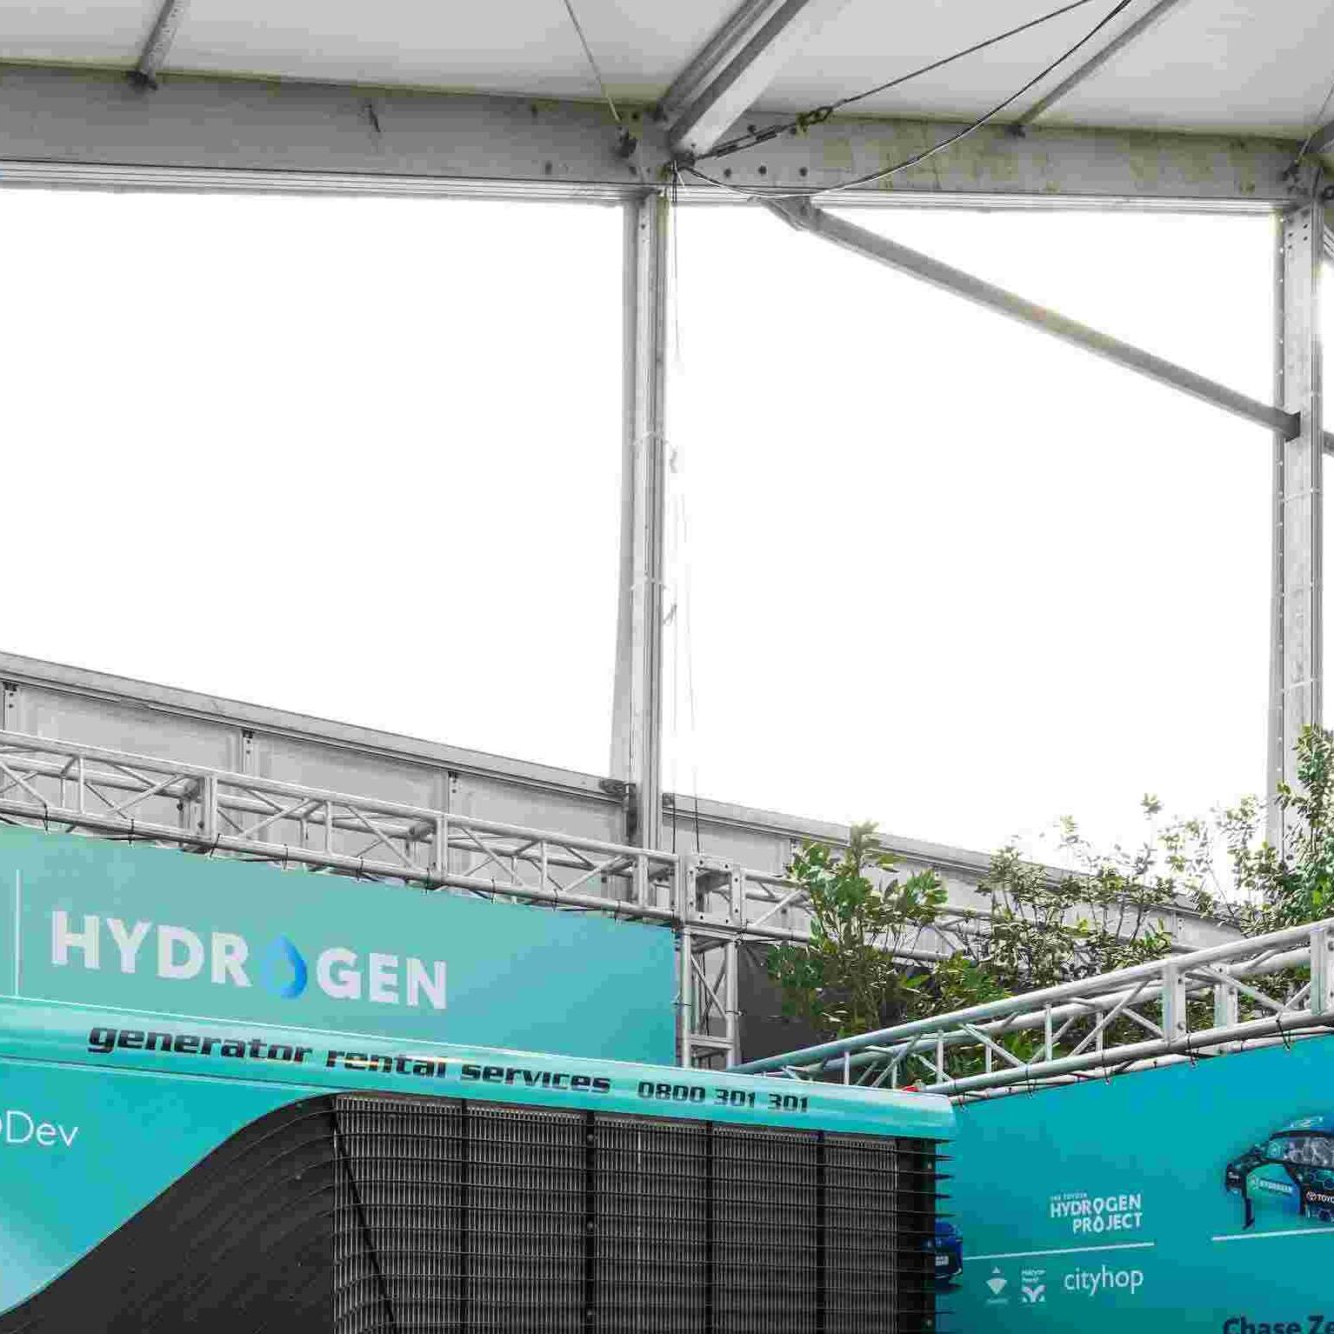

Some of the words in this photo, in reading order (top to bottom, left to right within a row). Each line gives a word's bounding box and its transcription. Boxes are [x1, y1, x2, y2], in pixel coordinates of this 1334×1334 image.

[53, 911, 446, 1009] HYDROGEN
[88, 1025, 313, 1063] generator
[325, 1049, 446, 1081] rental
[461, 1061, 611, 1094] services
[637, 1080, 705, 1103] 0800
[715, 1087, 755, 1109] 301
[769, 1091, 809, 1113] 301
[1050, 1193, 1142, 1218] HYDROGEN
[1072, 1212, 1143, 1234] PROJECT
[1063, 1264, 1144, 1297] cityhop
